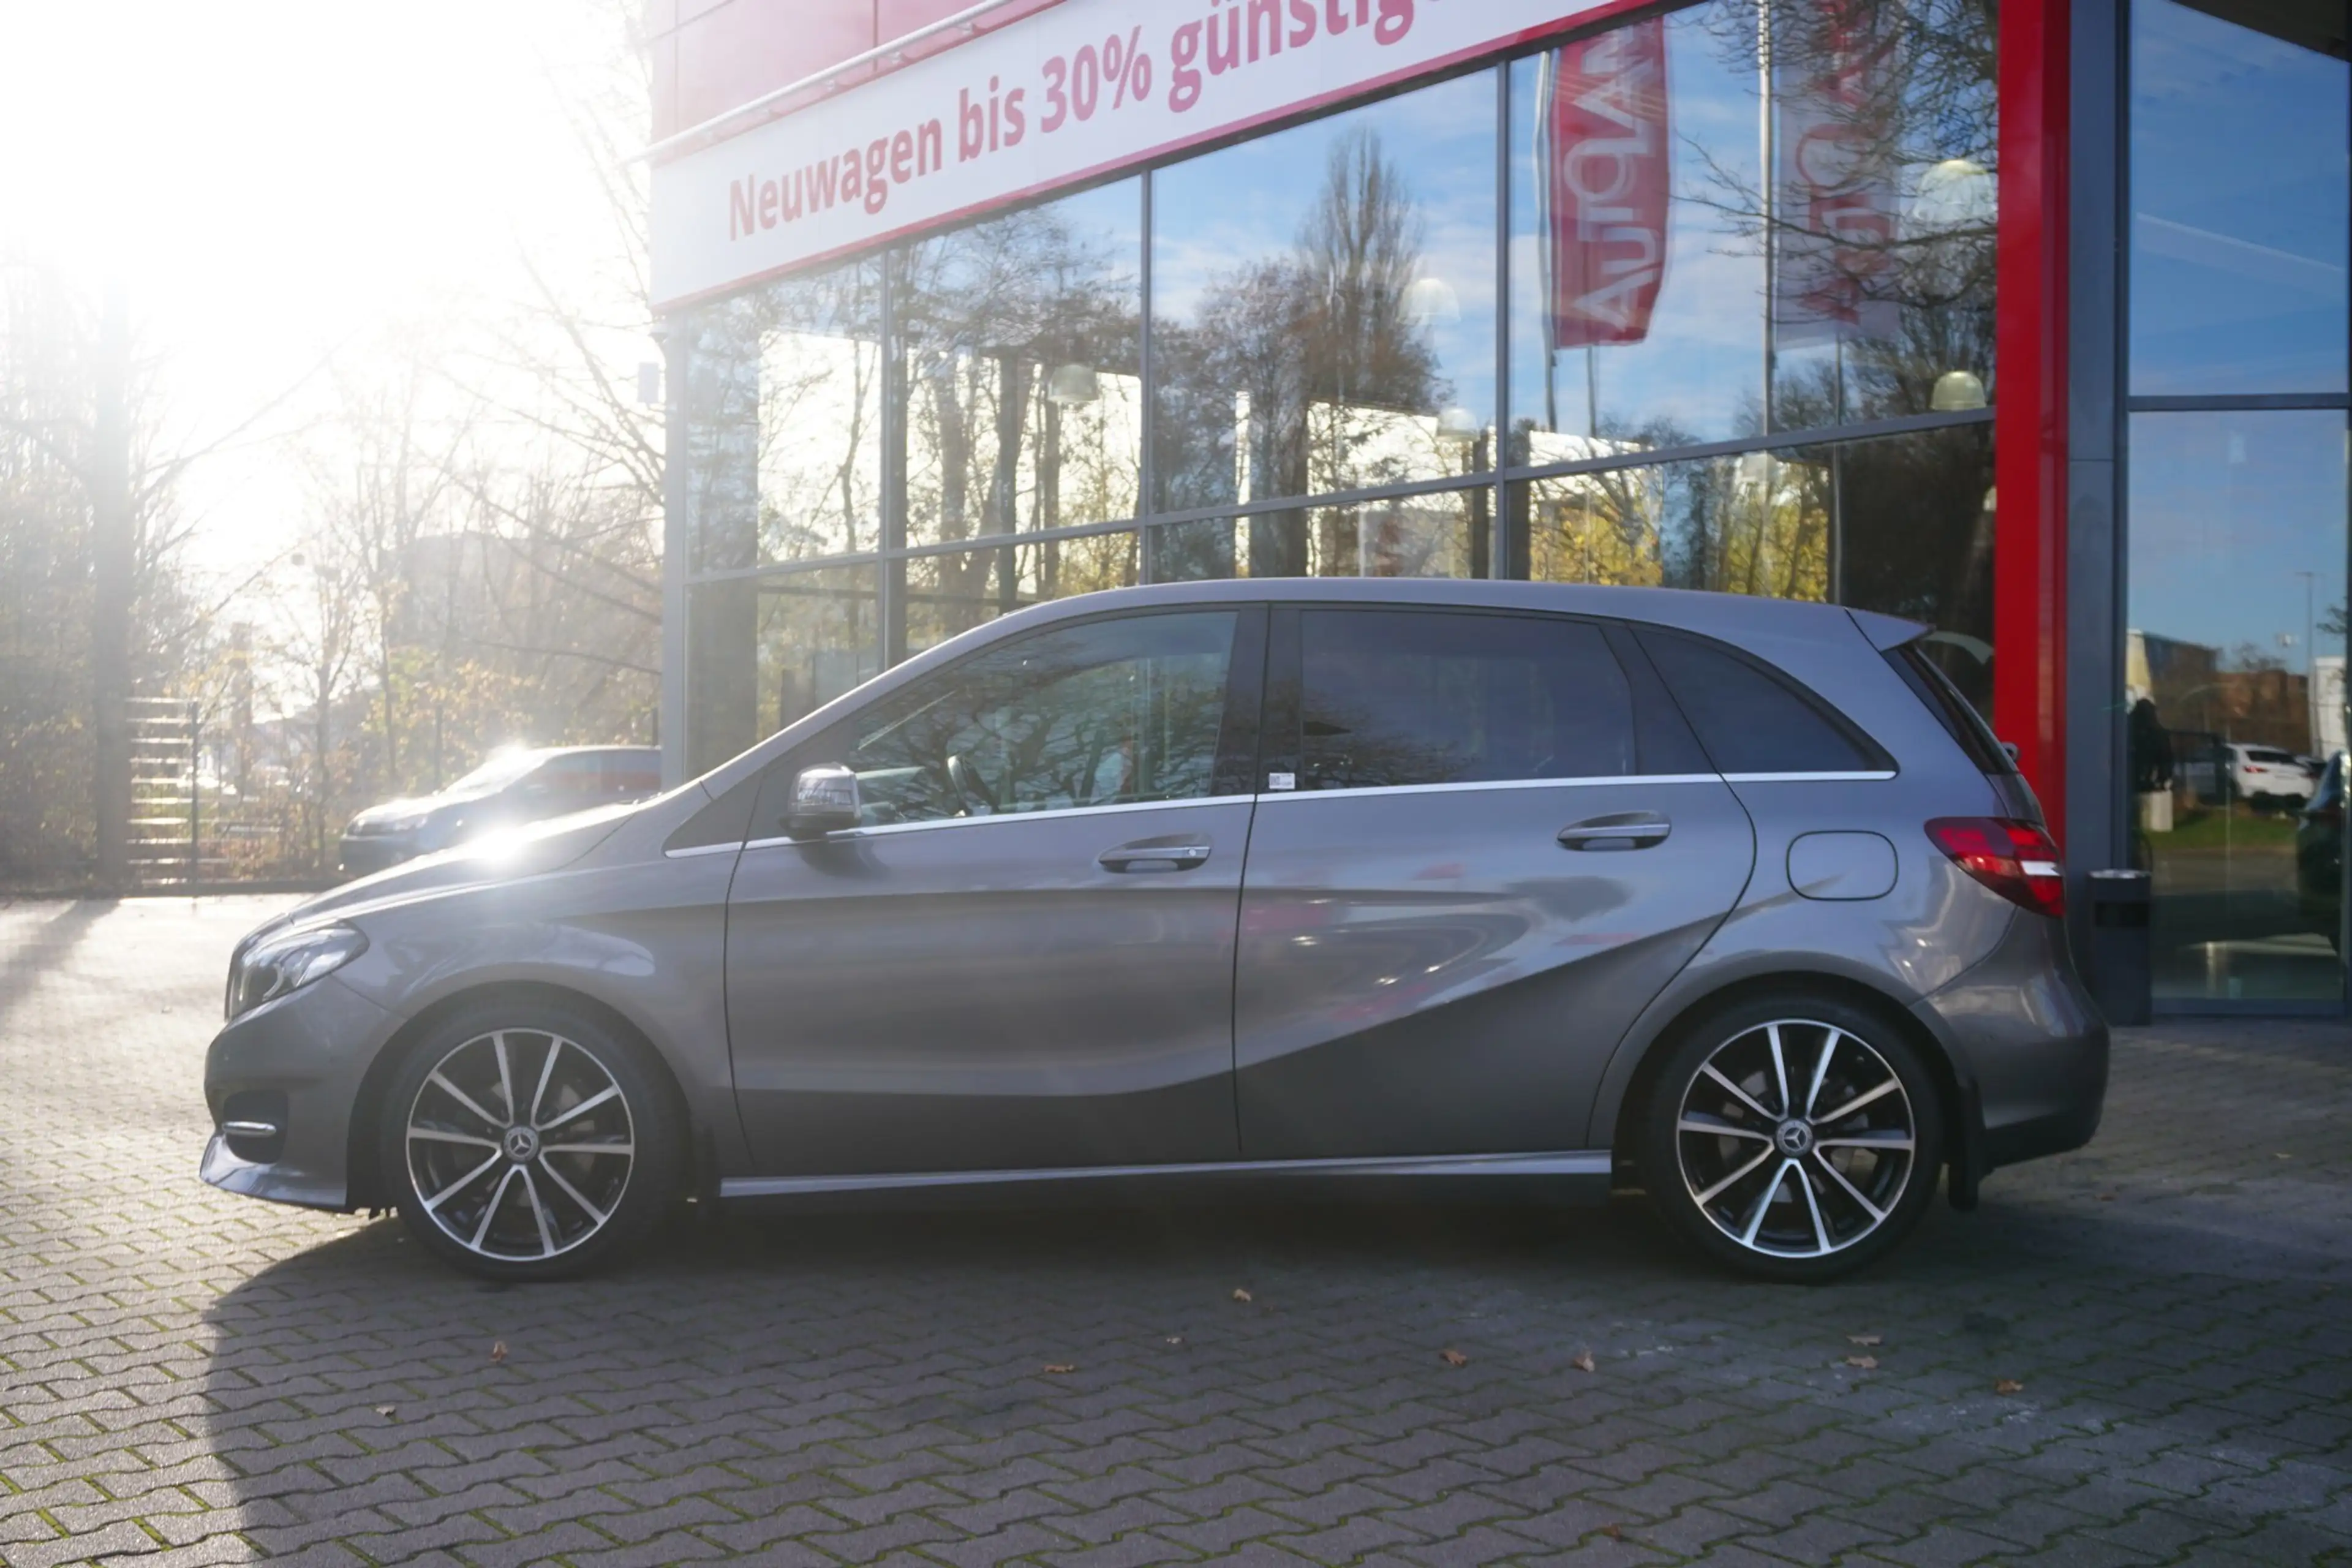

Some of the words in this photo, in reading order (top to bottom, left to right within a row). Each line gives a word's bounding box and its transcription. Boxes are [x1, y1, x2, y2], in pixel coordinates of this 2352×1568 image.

[729, 118, 942, 241] Neuwagen
[959, 75, 1025, 162] bis
[1041, 25, 1152, 133] 30%
